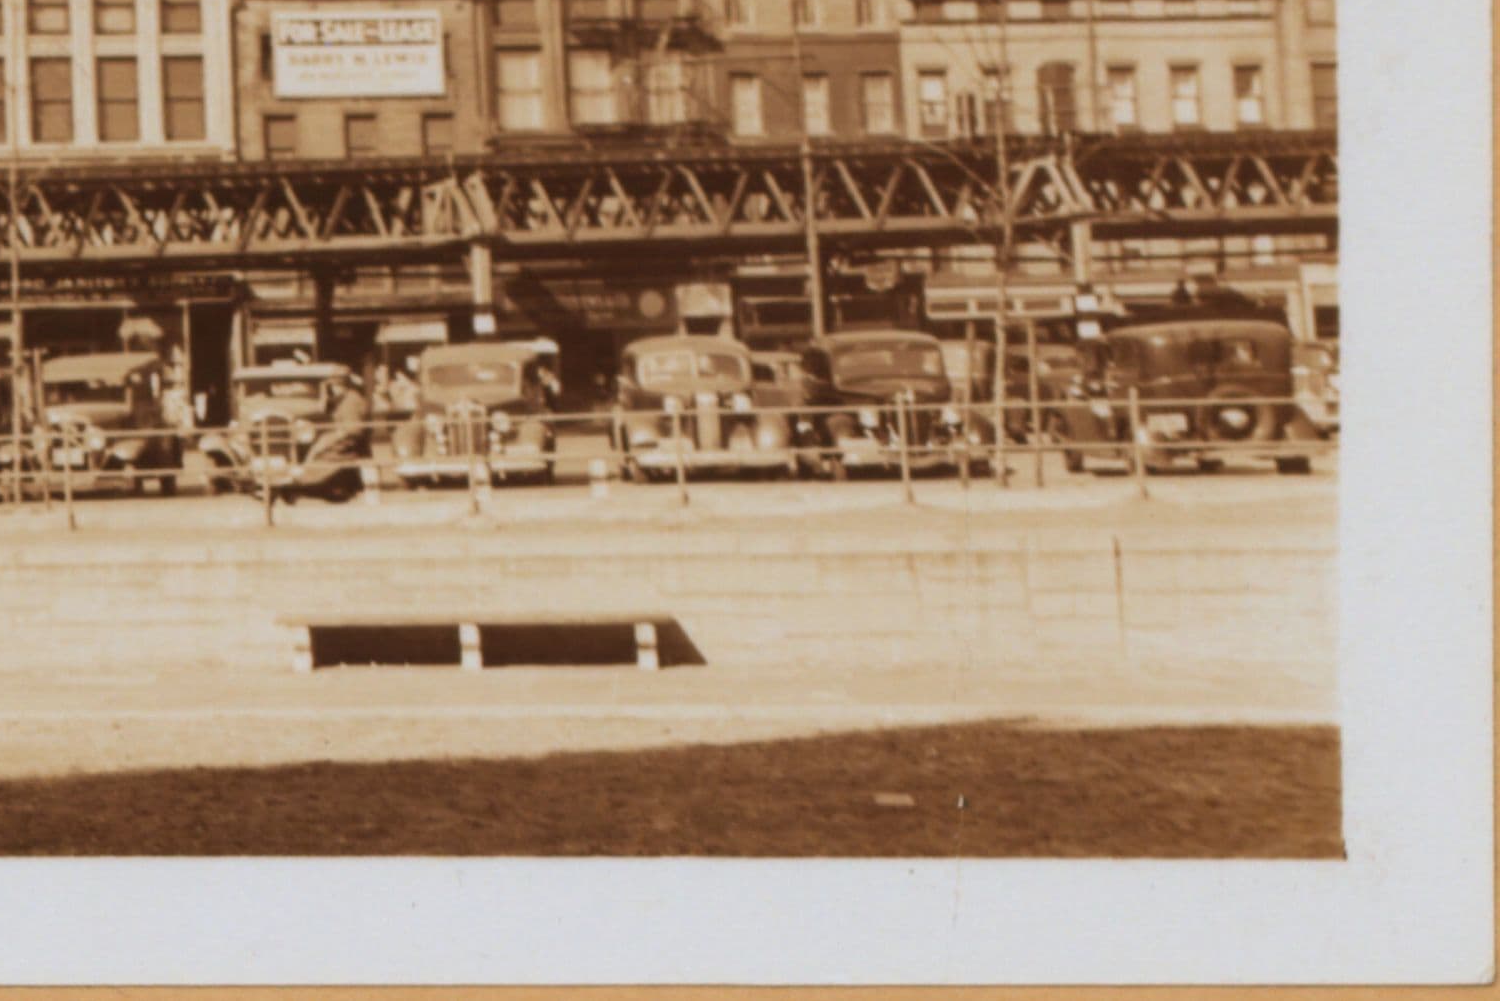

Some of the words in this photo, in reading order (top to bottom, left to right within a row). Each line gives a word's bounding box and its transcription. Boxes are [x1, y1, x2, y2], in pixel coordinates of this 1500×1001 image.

[278, 21, 316, 43] FOR
[322, 21, 363, 43] SALE
[380, 20, 436, 42] LEASE
